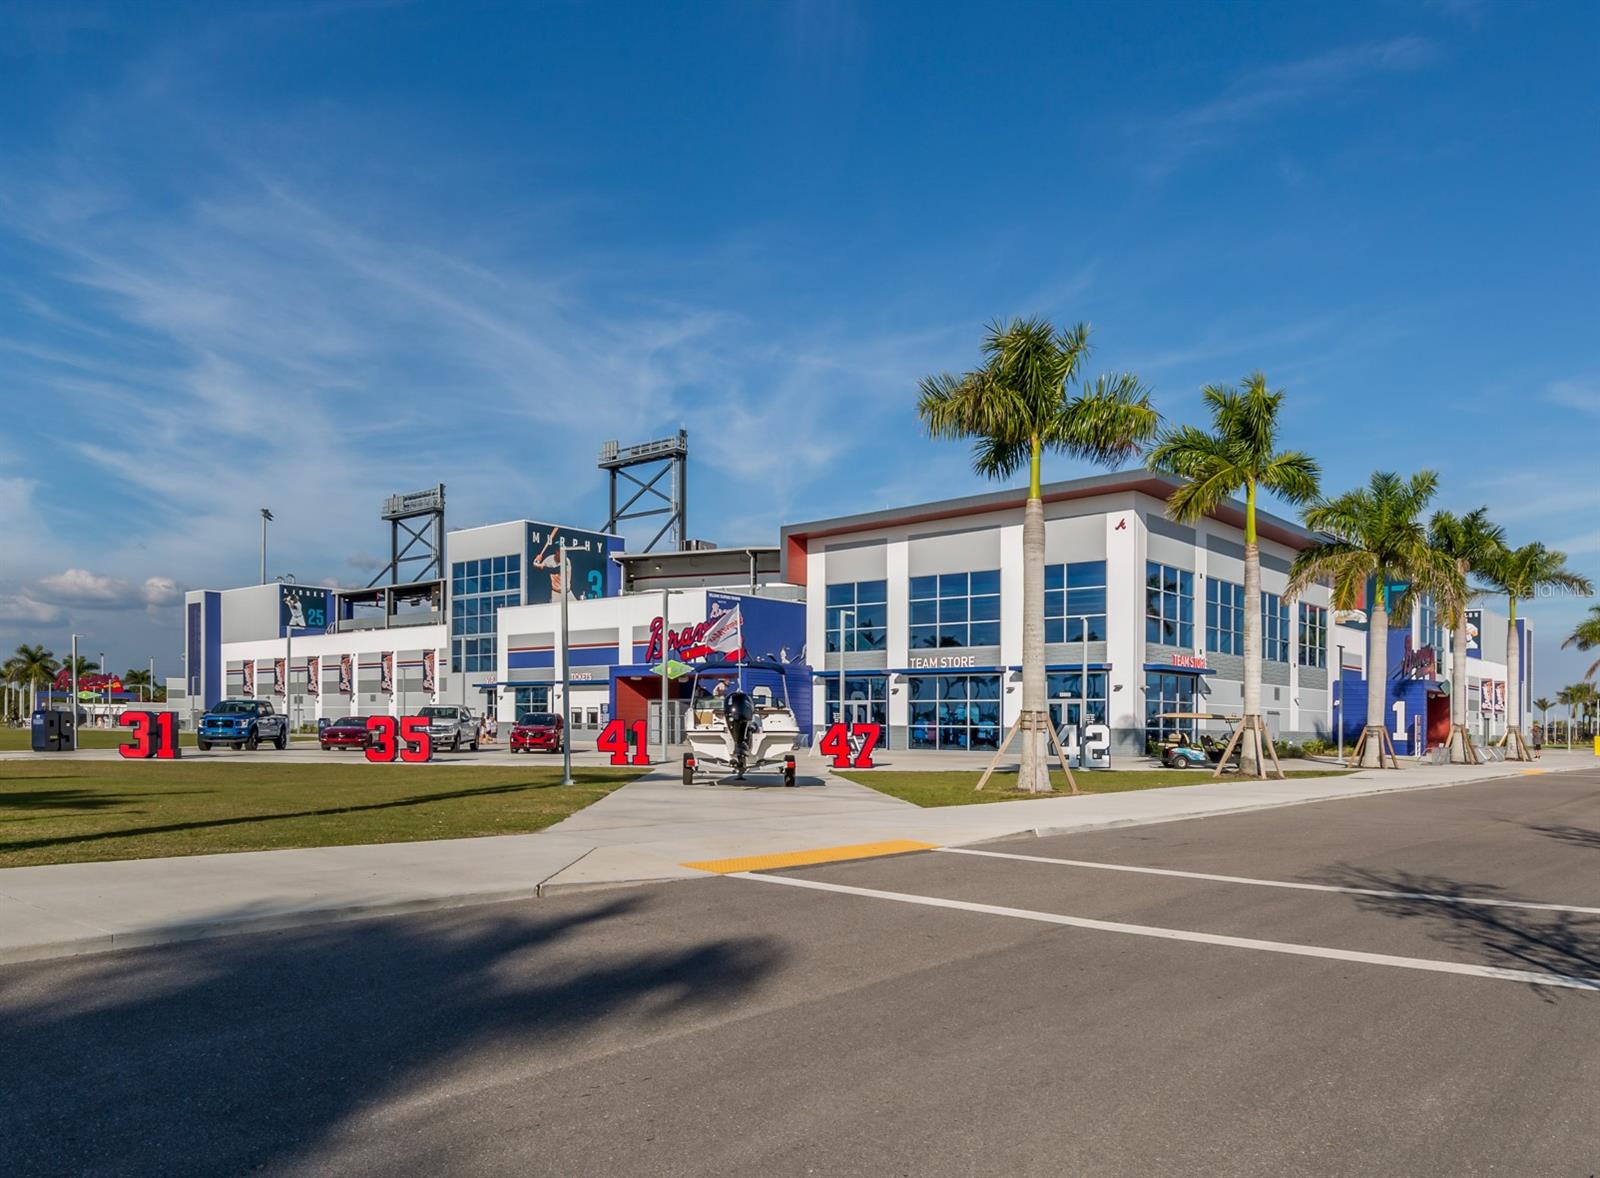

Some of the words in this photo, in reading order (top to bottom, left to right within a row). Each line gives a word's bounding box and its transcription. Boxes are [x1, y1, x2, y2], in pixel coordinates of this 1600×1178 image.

[533, 532, 603, 553] MURPHY
[307, 608, 325, 626] 25
[570, 672, 592, 681] TICKETS
[910, 657, 938, 669] TEAM
[940, 656, 975, 668] STORE
[1172, 655, 1190, 668] TEAM
[1190, 657, 1207, 669] STORE
[119, 711, 177, 758] 31
[366, 715, 431, 762] 35
[597, 719, 650, 765] 41
[820, 723, 880, 768] 47
[1048, 723, 1111, 768] 42
